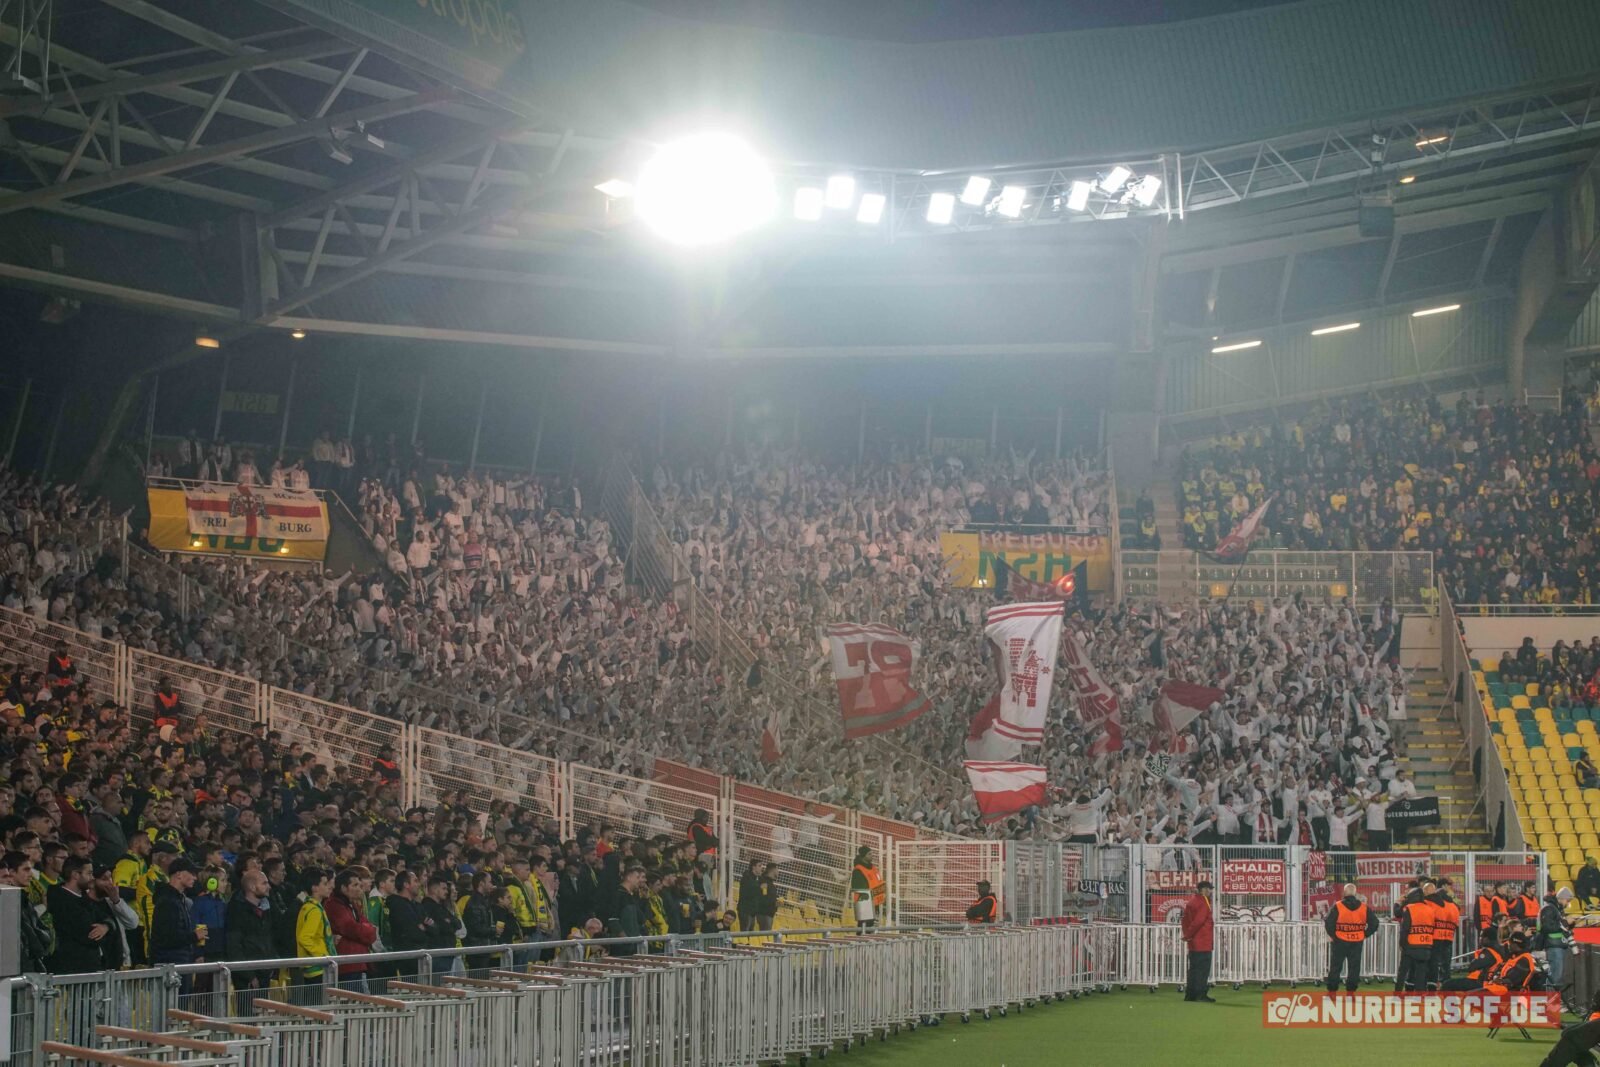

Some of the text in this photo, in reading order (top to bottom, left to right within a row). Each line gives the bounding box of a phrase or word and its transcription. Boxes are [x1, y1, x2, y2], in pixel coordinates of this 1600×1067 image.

[279, 522, 312, 533] BURG
[1224, 863, 1281, 873] KHALID
[1224, 873, 1244, 882] FÜR
